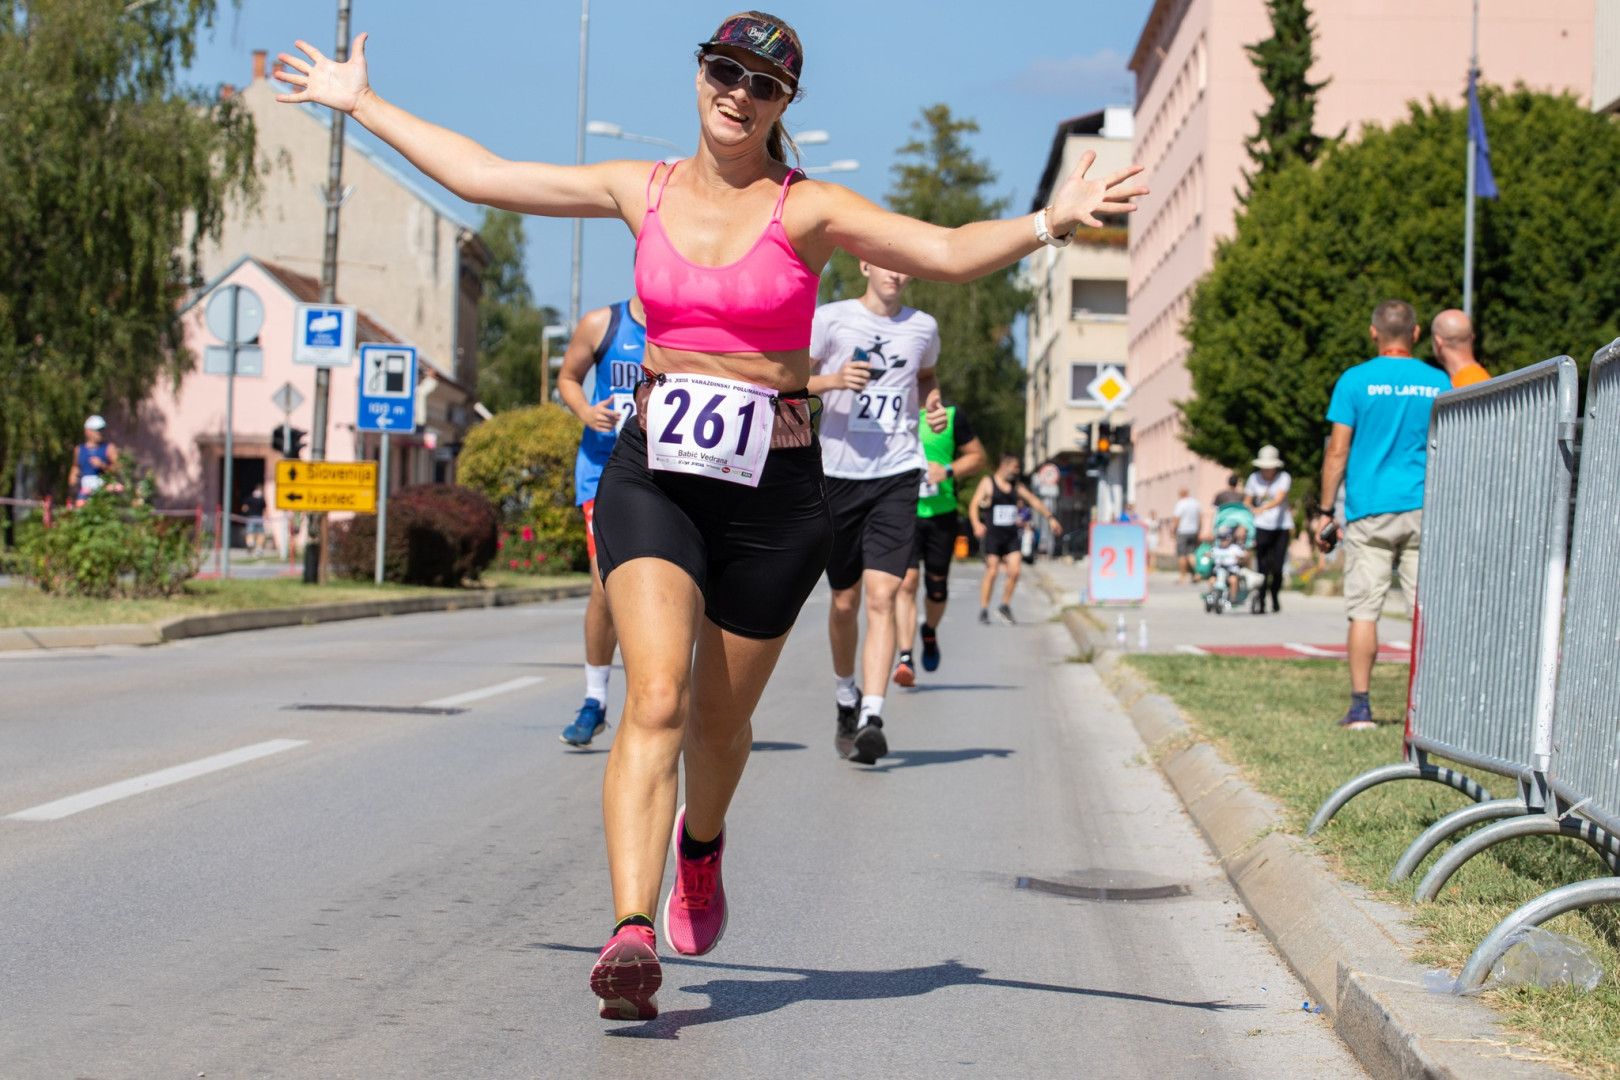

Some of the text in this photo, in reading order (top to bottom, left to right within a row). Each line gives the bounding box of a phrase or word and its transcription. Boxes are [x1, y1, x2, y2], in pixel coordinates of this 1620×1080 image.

[1367, 384, 1393, 396] DVD
[857, 394, 903, 420] 279
[658, 388, 756, 456] 261
[677, 449, 698, 459] Babić
[700, 452, 728, 465] Vedrana
[307, 462, 372, 485] Slovenija
[307, 488, 356, 505] Ivanec
[1098, 546, 1135, 577] 21
